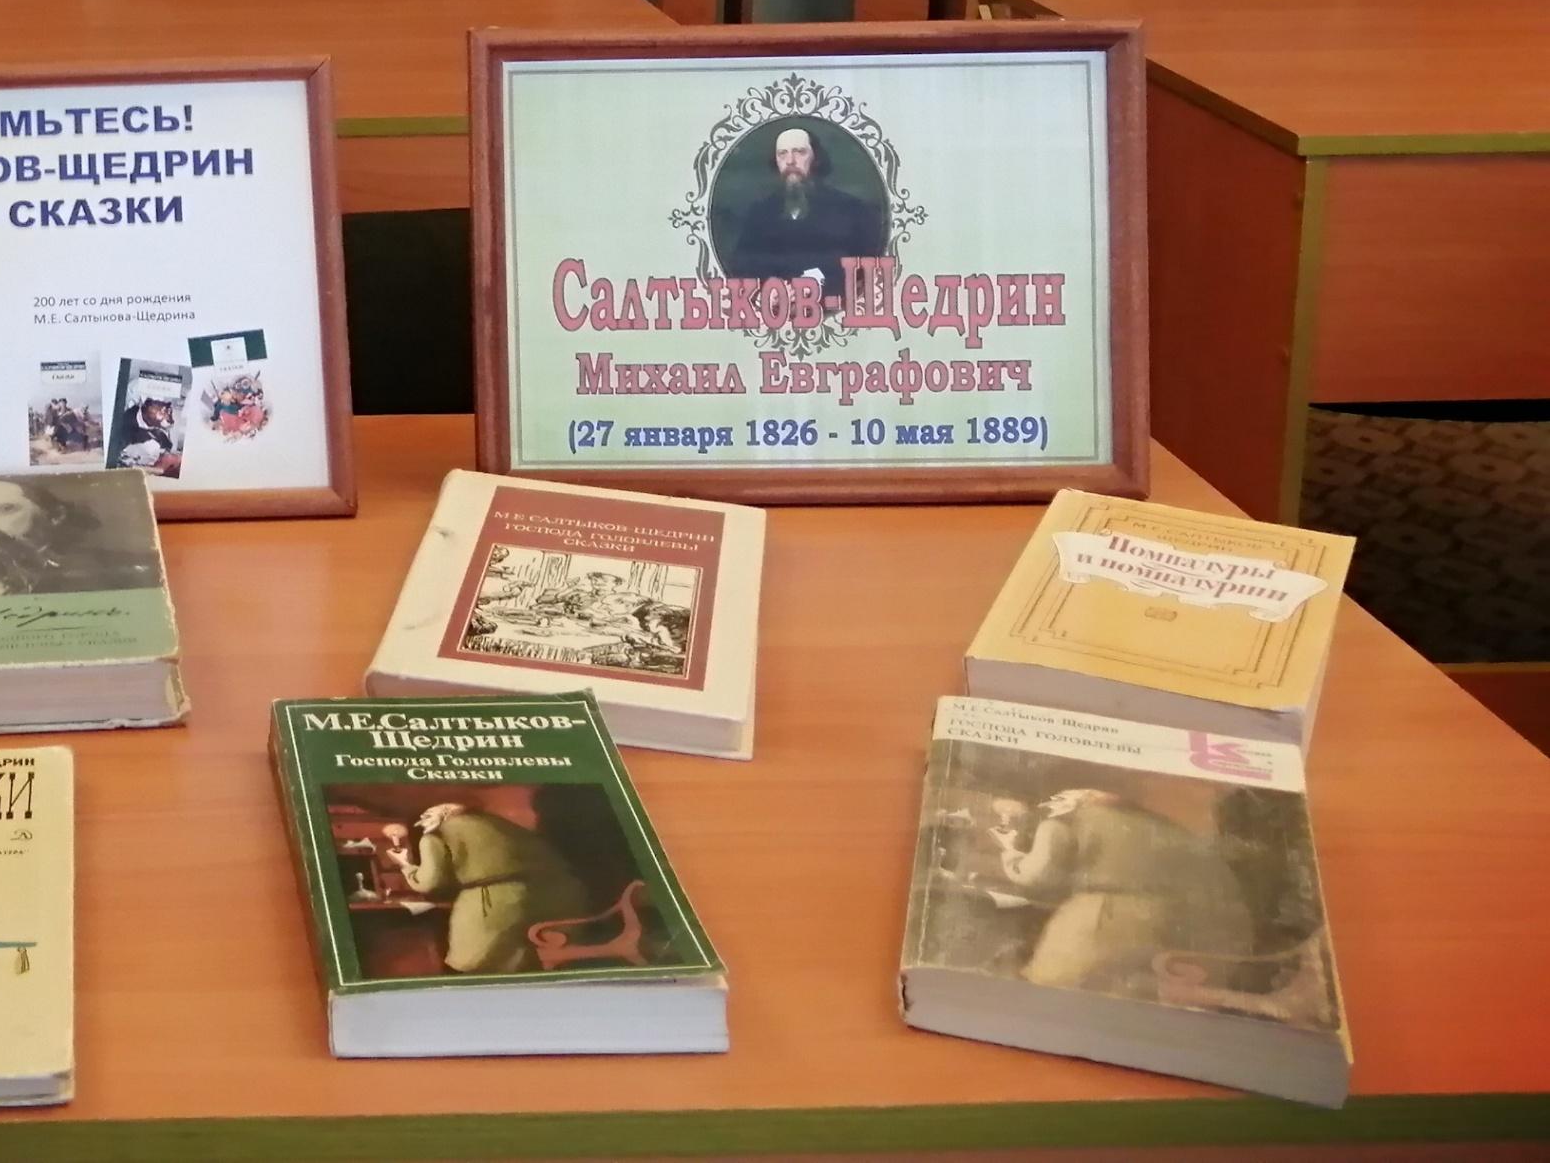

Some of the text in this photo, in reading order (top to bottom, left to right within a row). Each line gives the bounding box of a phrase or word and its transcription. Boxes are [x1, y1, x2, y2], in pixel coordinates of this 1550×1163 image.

[9, 195, 185, 228] СКАЗКИ
[33, 293, 192, 308] 200 лет со дня рождения
[552, 256, 1066, 349] Салтыков-Щедрин
[34, 310, 196, 325] М.Е. Салтыкова-Щедрина
[576, 347, 1033, 406] Михаил Евграфович
[567, 418, 615, 454] (27
[623, 423, 734, 454] января
[746, 419, 818, 447] 1826
[850, 419, 886, 446] 10
[895, 424, 954, 446] мая
[966, 416, 1049, 451] 1889)
[505, 522, 700, 552] ГОСПОДА ГОЛОВЛЕВЫ
[562, 538, 636, 553] СКАЗКИ
[1108, 534, 1278, 581] Помпадуры
[1076, 551, 1289, 602] и помпадурши
[371, 731, 525, 751] Щедрин
[947, 728, 1019, 745] СКАЗКИ
[950, 718, 1142, 756] ГОСПОДА ГОЛОВЛЕВЫ
[335, 753, 573, 769] Господа Головлевы
[406, 768, 504, 781] Сказки
